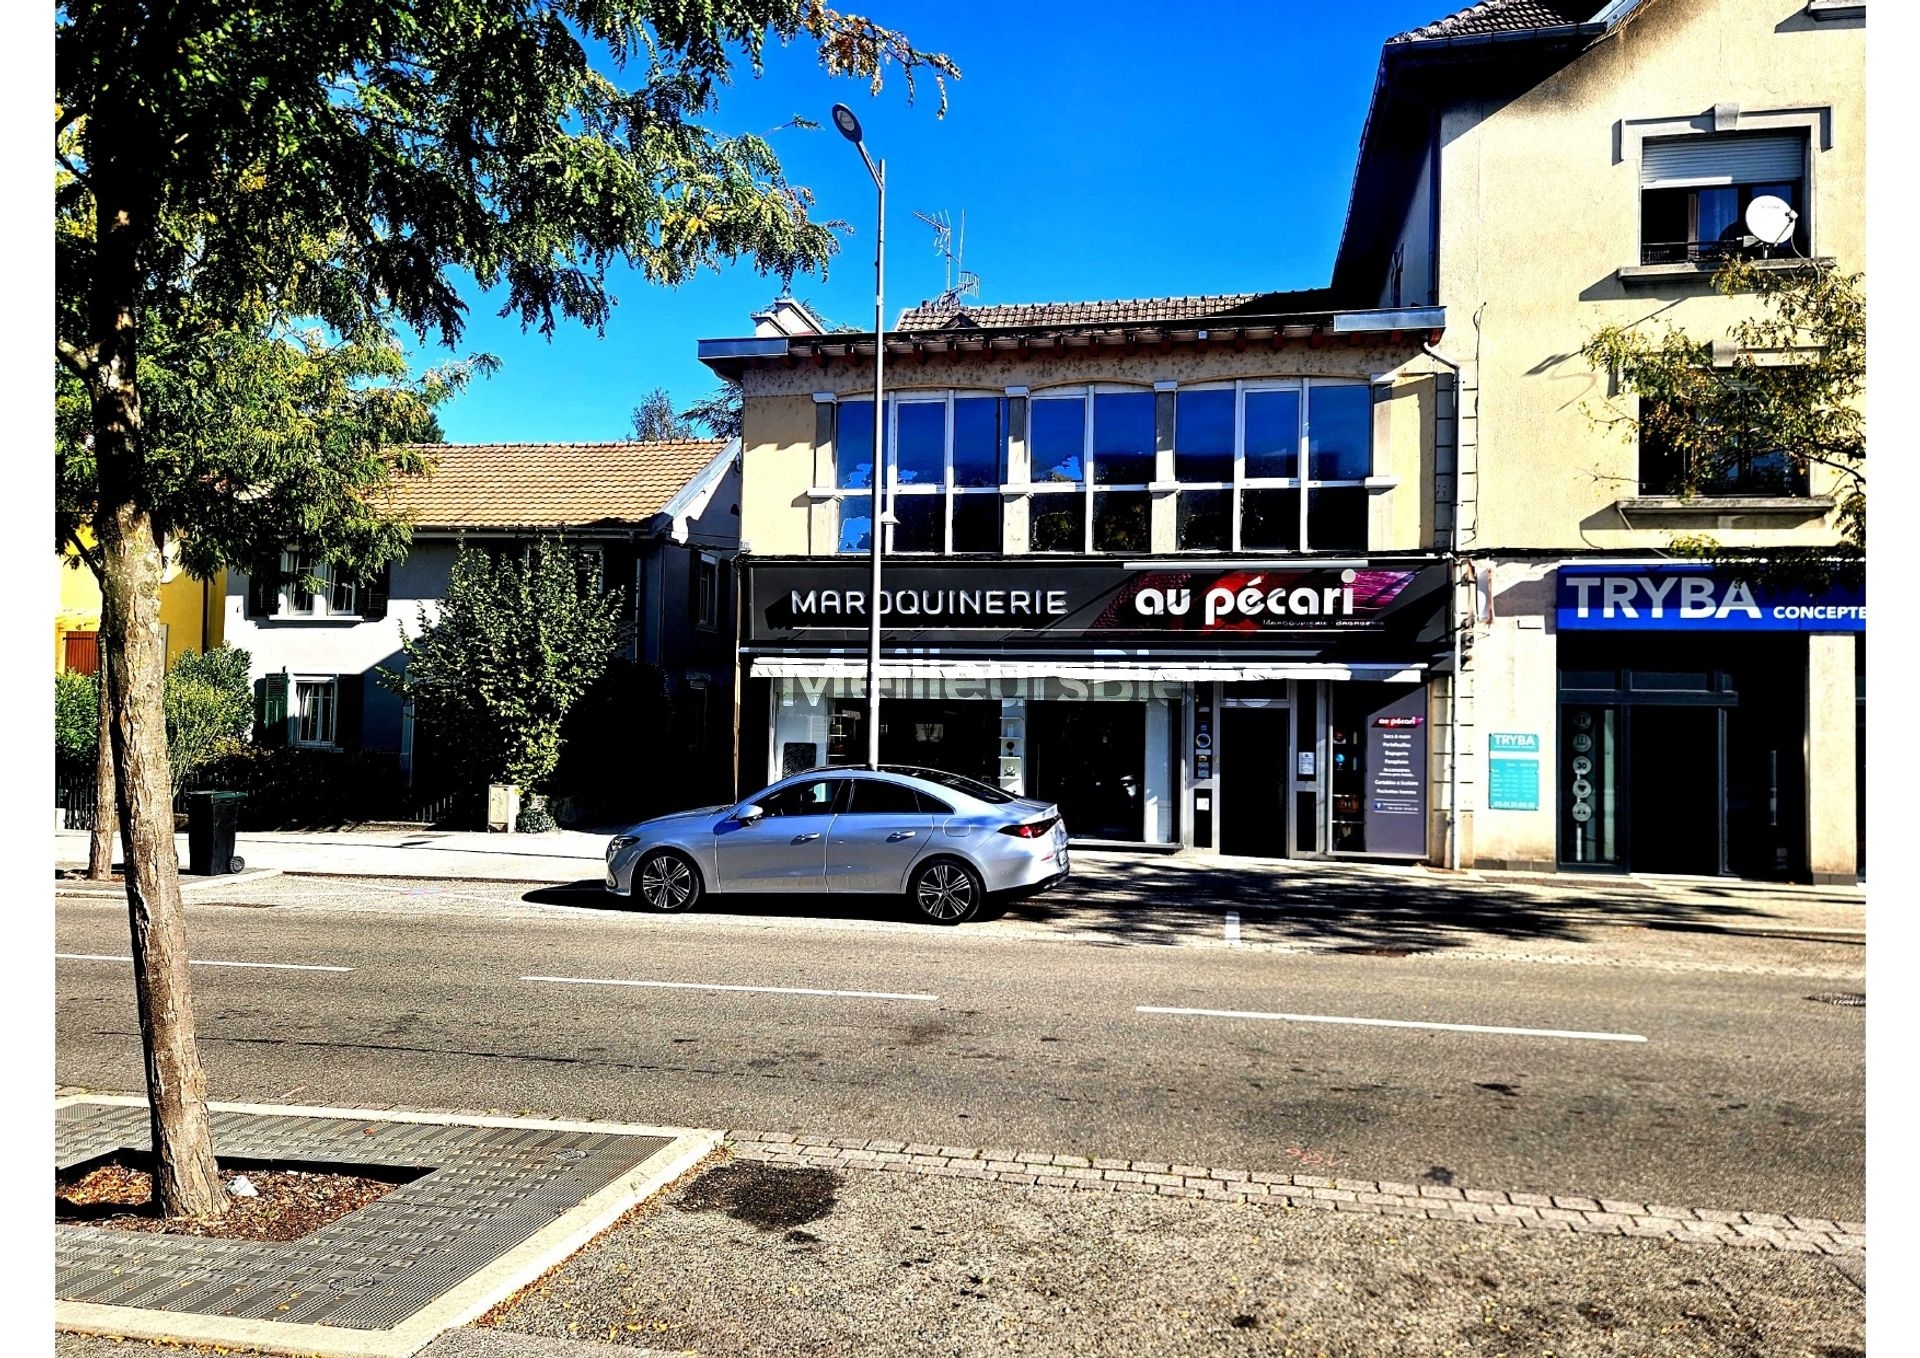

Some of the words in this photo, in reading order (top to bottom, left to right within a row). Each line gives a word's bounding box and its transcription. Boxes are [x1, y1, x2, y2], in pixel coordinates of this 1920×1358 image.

[1135, 588, 1191, 616] au
[1205, 570, 1356, 626] pécari
[1566, 577, 1762, 619] TRYBA
[1494, 734, 1536, 746] TRYBA
